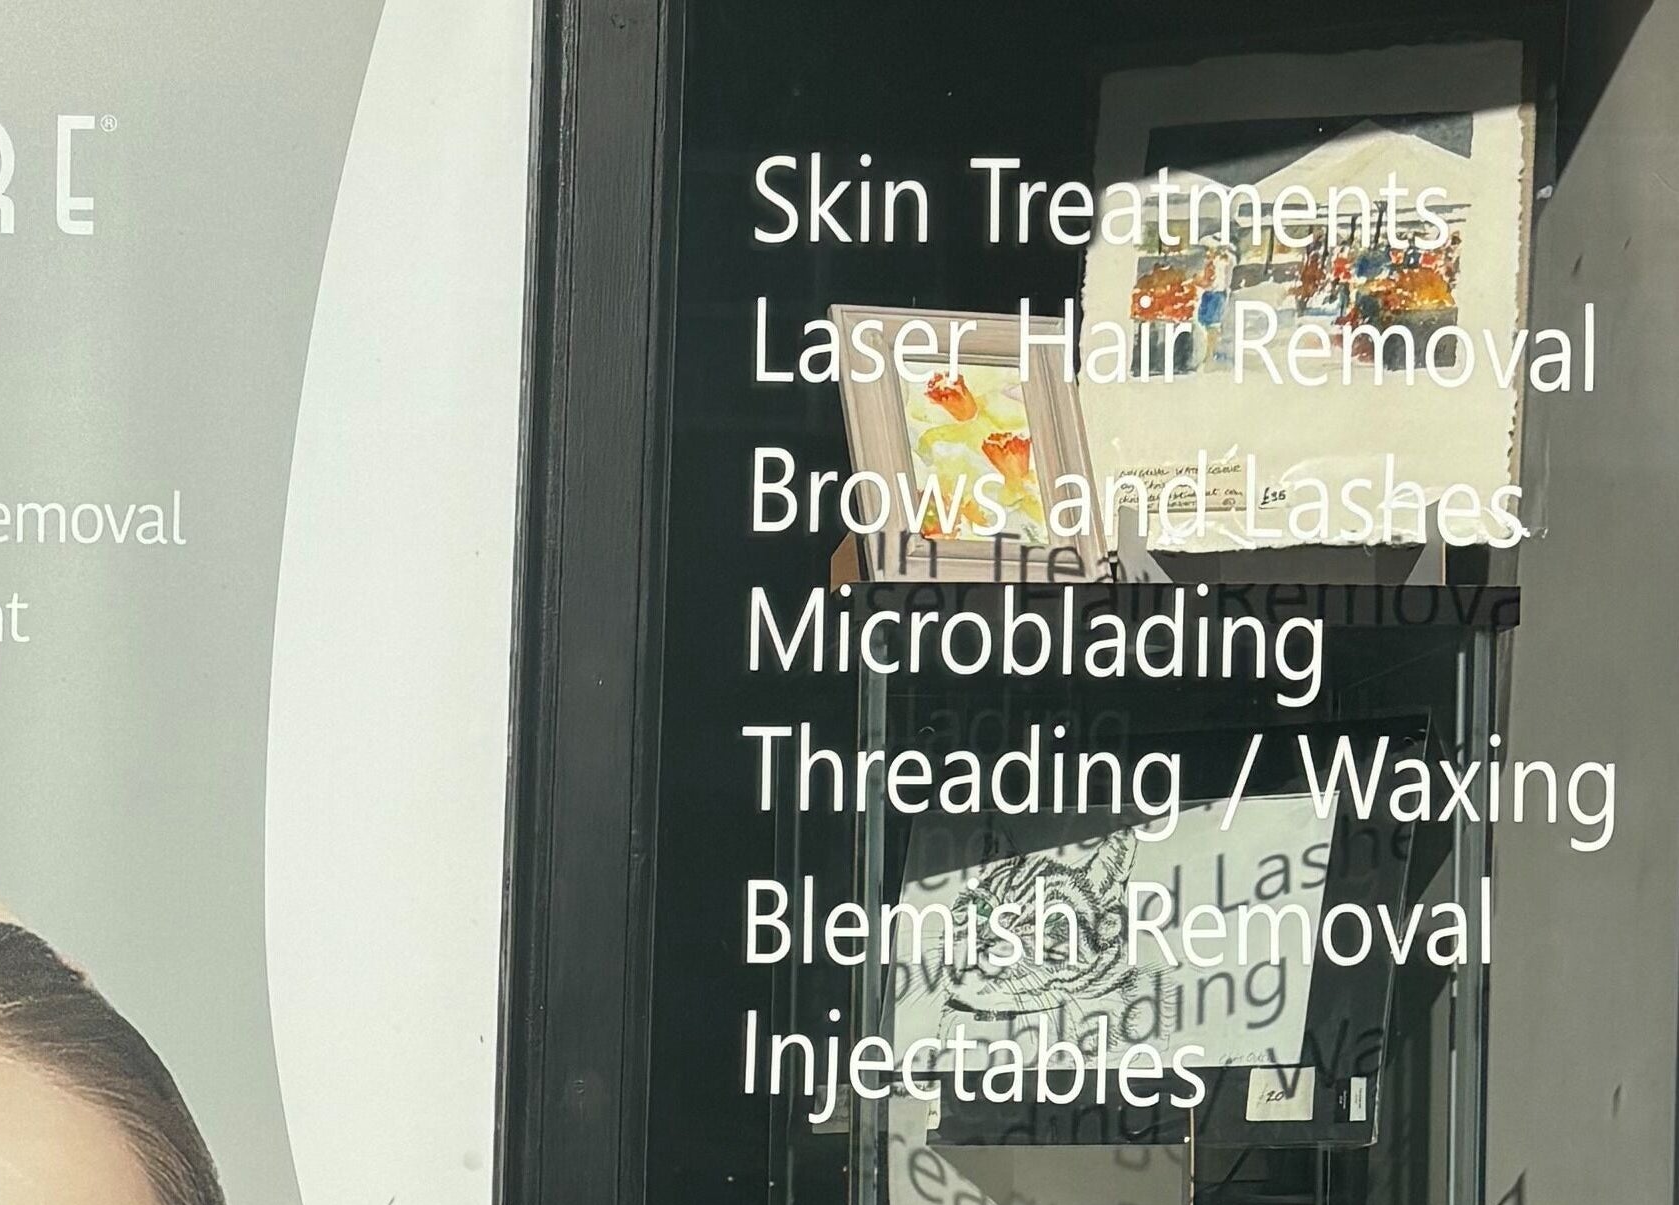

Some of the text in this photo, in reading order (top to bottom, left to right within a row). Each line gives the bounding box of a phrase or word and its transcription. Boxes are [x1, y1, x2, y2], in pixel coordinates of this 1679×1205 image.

[752, 154, 1451, 251] Skin Treatments
[753, 296, 1597, 393] Laser Hair Removal
[751, 446, 1526, 549] Brows and Lashes
[748, 583, 1325, 707] Microblading
[742, 723, 1617, 853] Threading / Waxing
[746, 876, 1080, 967] Blemish
[1126, 877, 1492, 967] Removal
[743, 1009, 1208, 1124] Injectables
